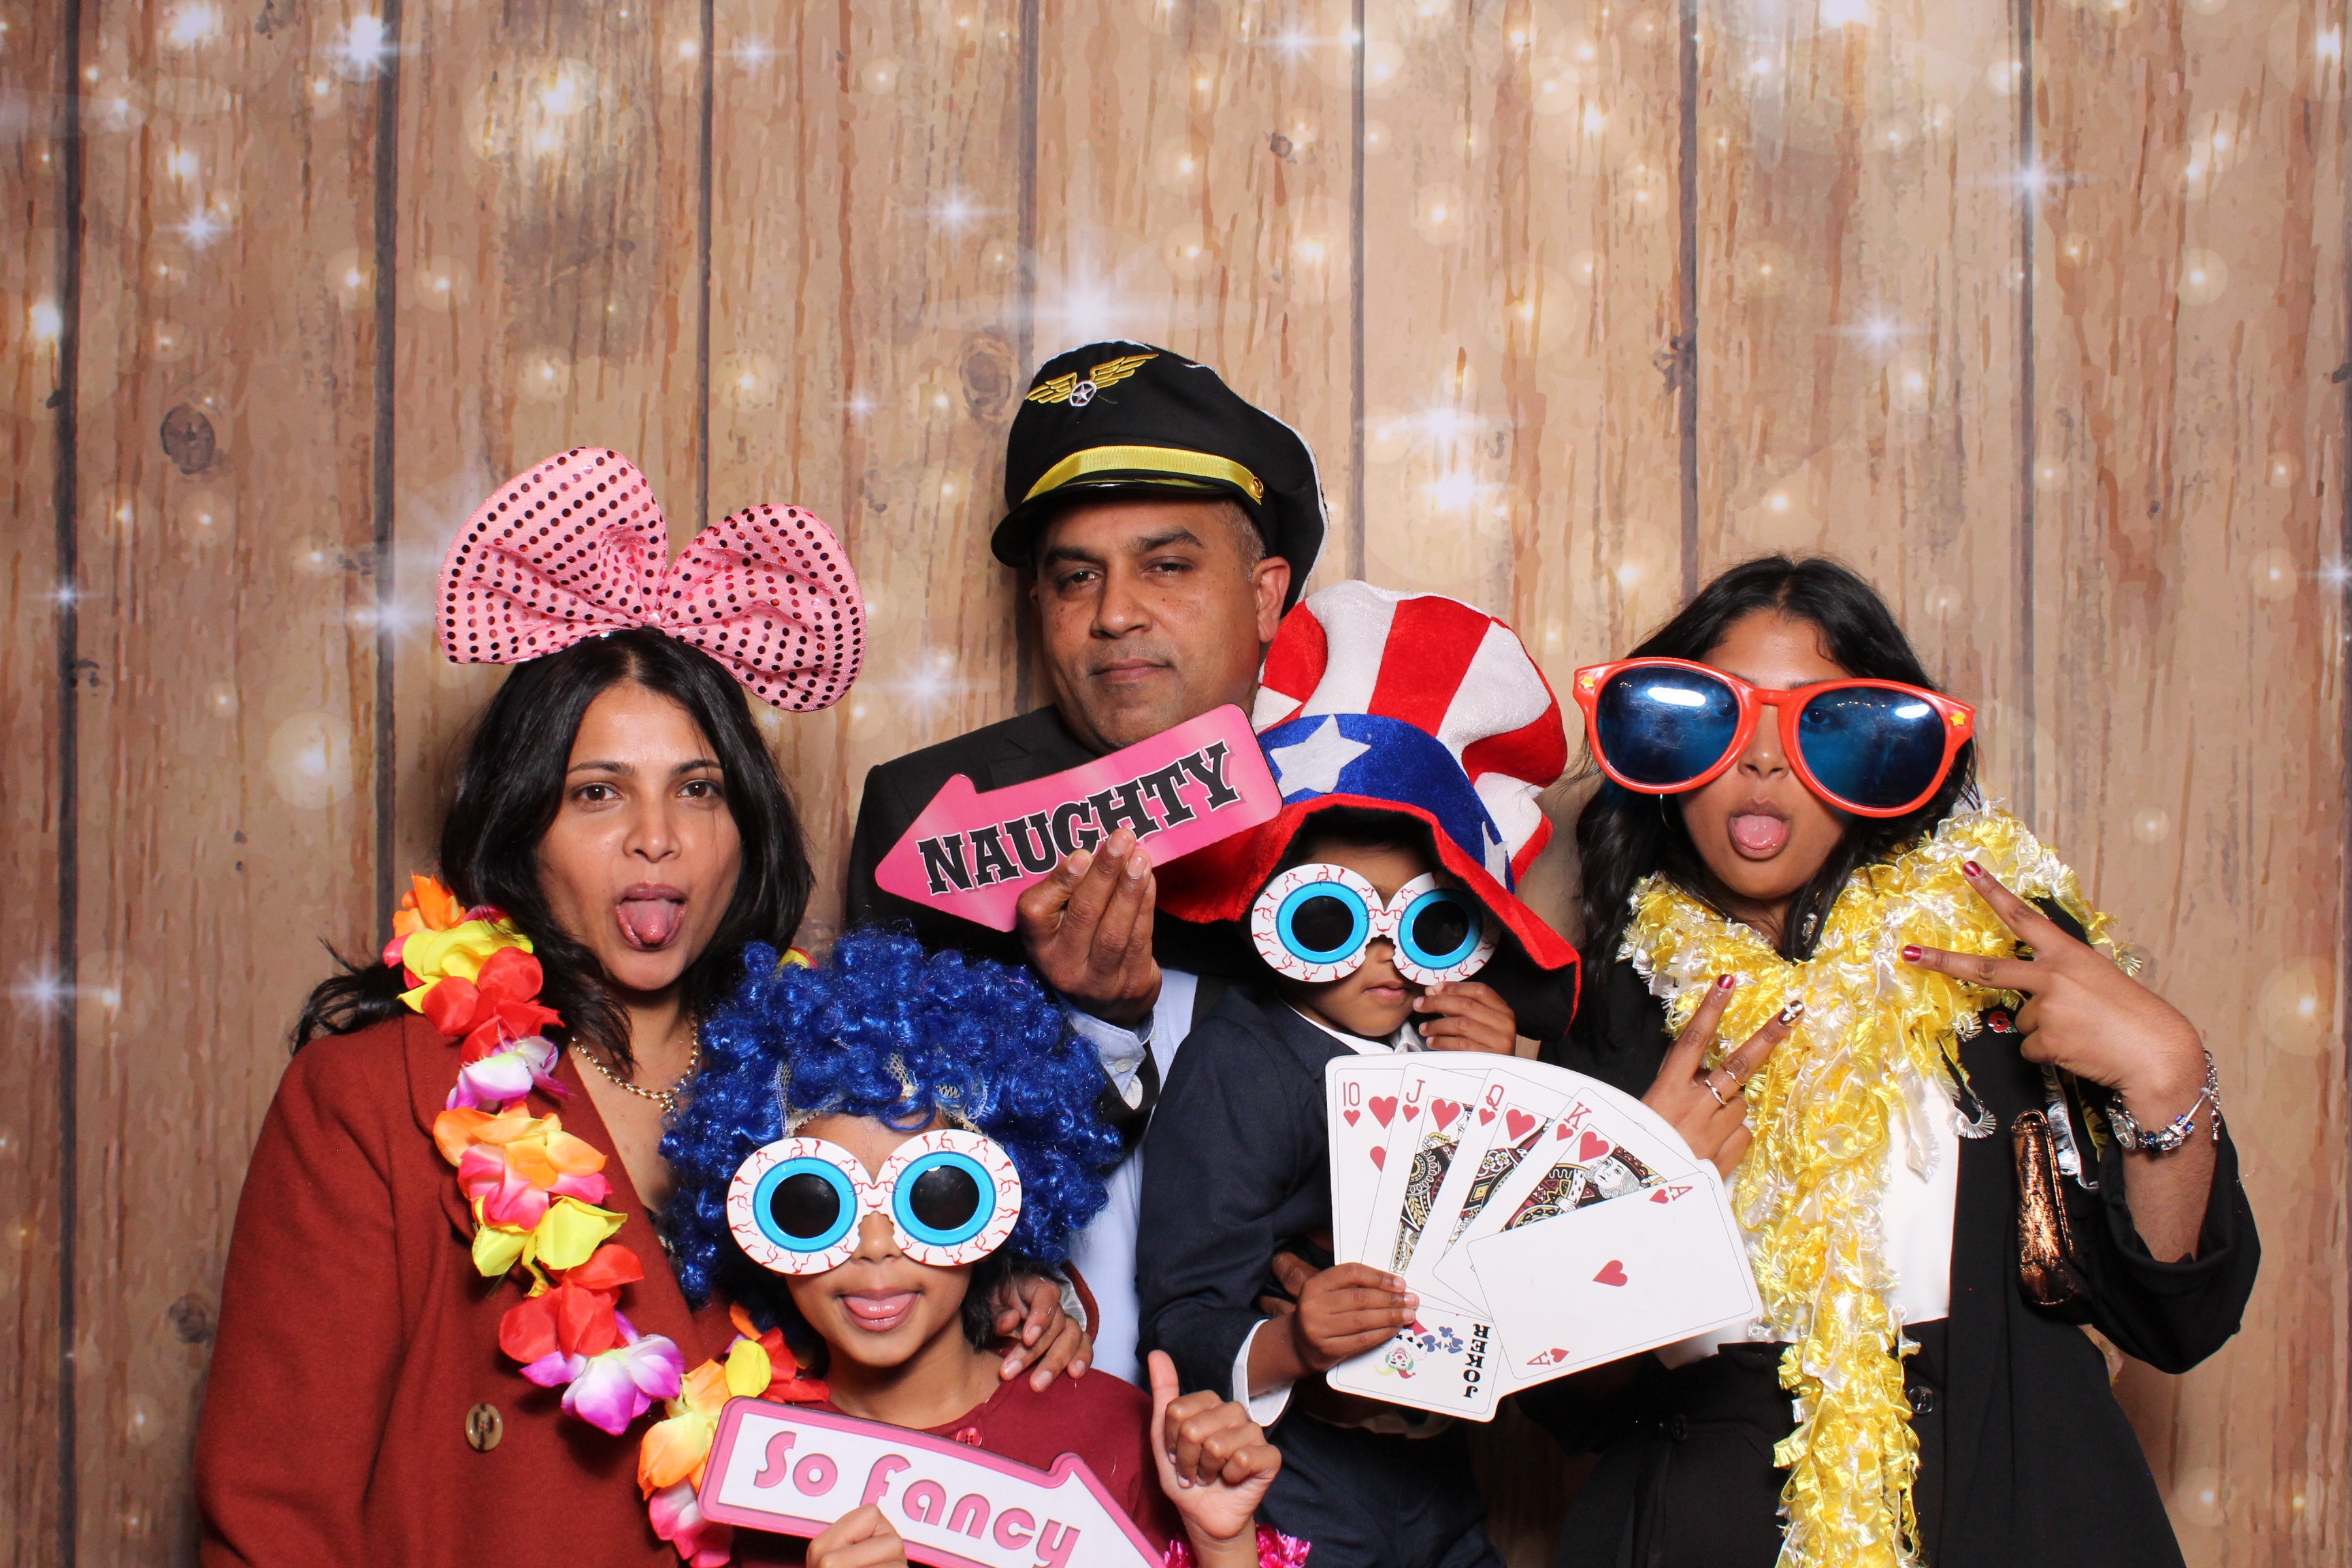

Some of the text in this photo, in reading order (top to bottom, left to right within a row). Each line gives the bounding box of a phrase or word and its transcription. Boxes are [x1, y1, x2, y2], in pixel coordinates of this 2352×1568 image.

[916, 738, 1241, 896] NAUGHTY
[1343, 1081, 1360, 1106] 10
[1406, 1079, 1426, 1103] J
[1486, 1083, 1505, 1111] Q
[1564, 1102, 1592, 1130] K
[1669, 1186, 1693, 1200] A
[1463, 1323, 1491, 1399] JOKER
[1526, 1351, 1551, 1366] A
[753, 1431, 838, 1497] So
